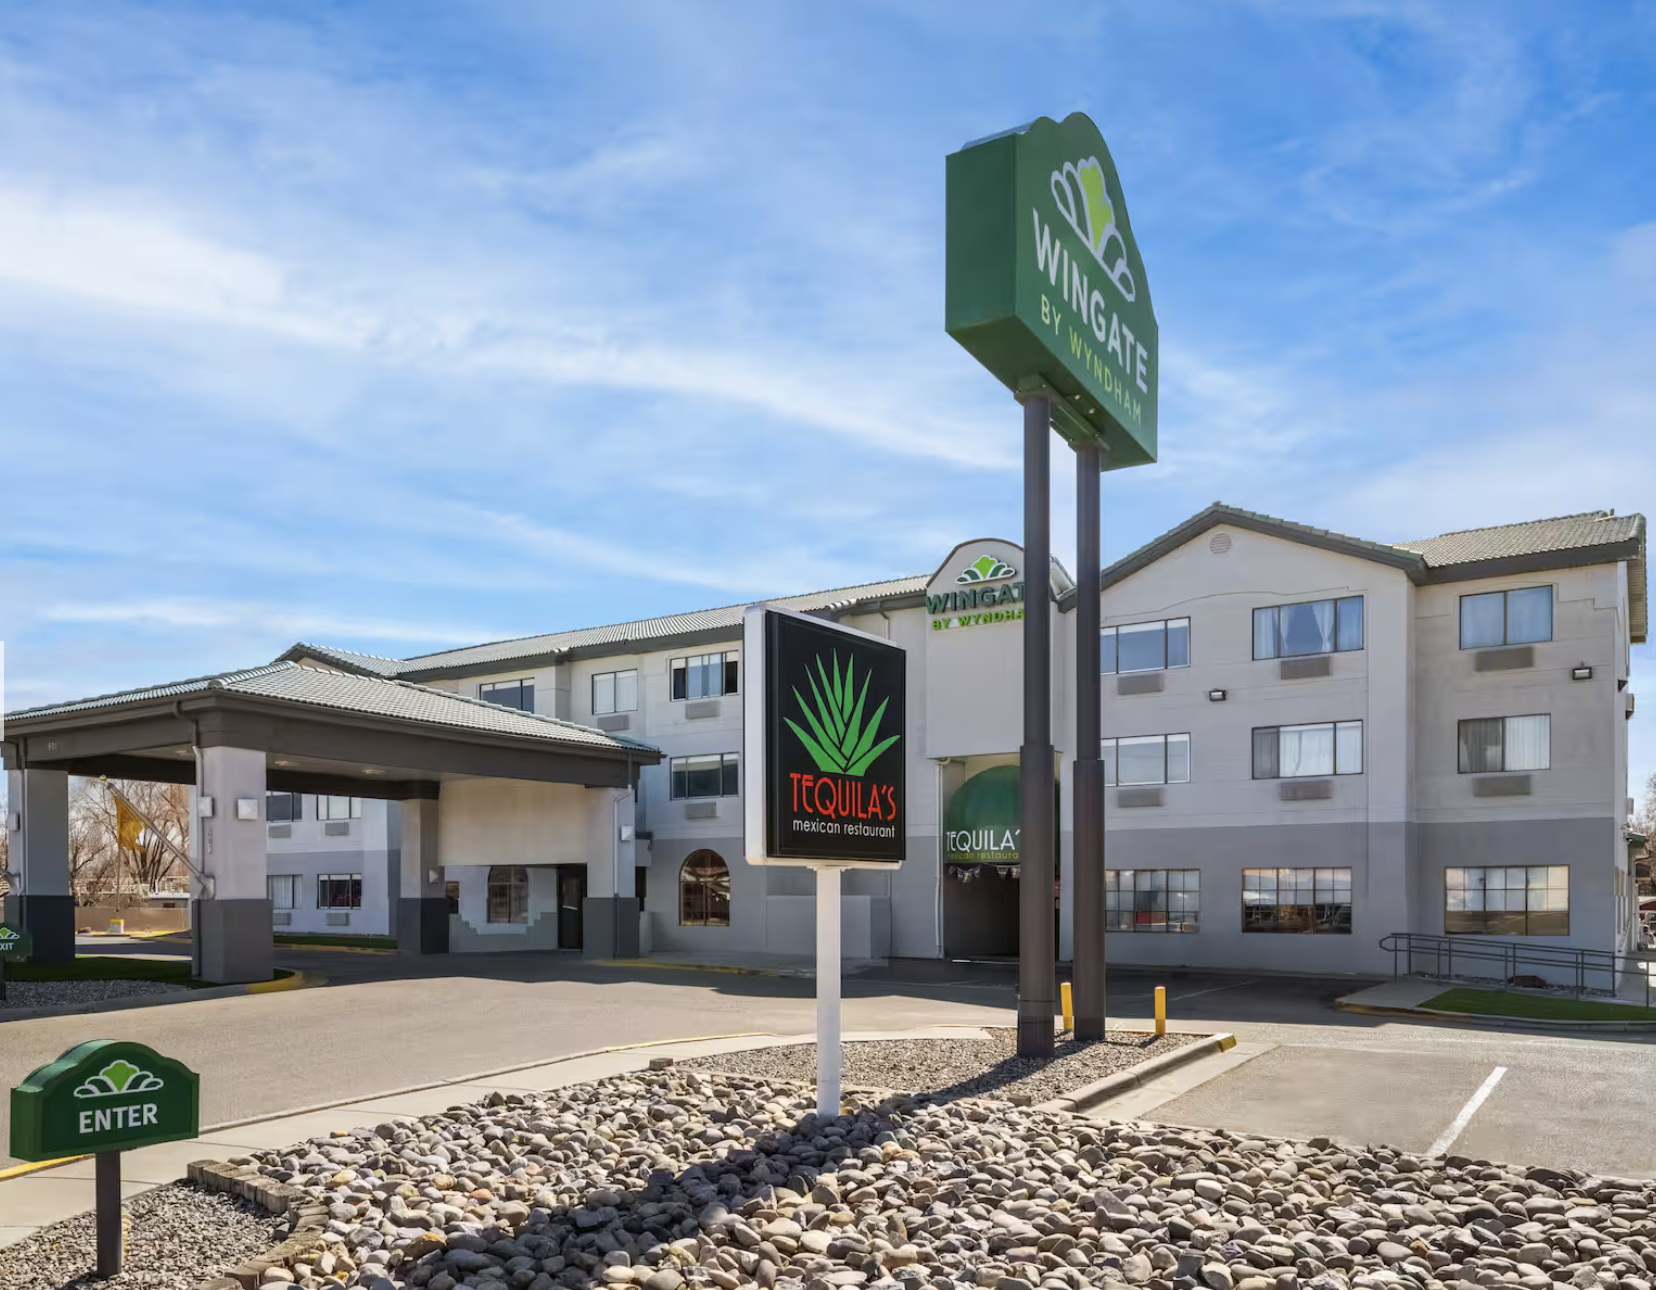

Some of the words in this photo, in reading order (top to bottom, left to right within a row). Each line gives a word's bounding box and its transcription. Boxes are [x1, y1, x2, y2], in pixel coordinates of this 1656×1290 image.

[1032, 208, 1148, 393] WINGATE
[1041, 293, 1061, 336] BY
[1069, 326, 1141, 424] WYNDHAM
[925, 581, 1025, 615] WINGAT
[932, 618, 952, 631] BY
[958, 608, 1025, 627] WYNDHA
[790, 772, 896, 820] TEQUILA'S
[792, 818, 841, 835] mexican
[844, 821, 895, 839] restaurant
[946, 829, 1021, 853] TEQUILA'
[977, 850, 1019, 860] restaura
[0, 942, 14, 951] XIT
[79, 1103, 158, 1134] ENTER
